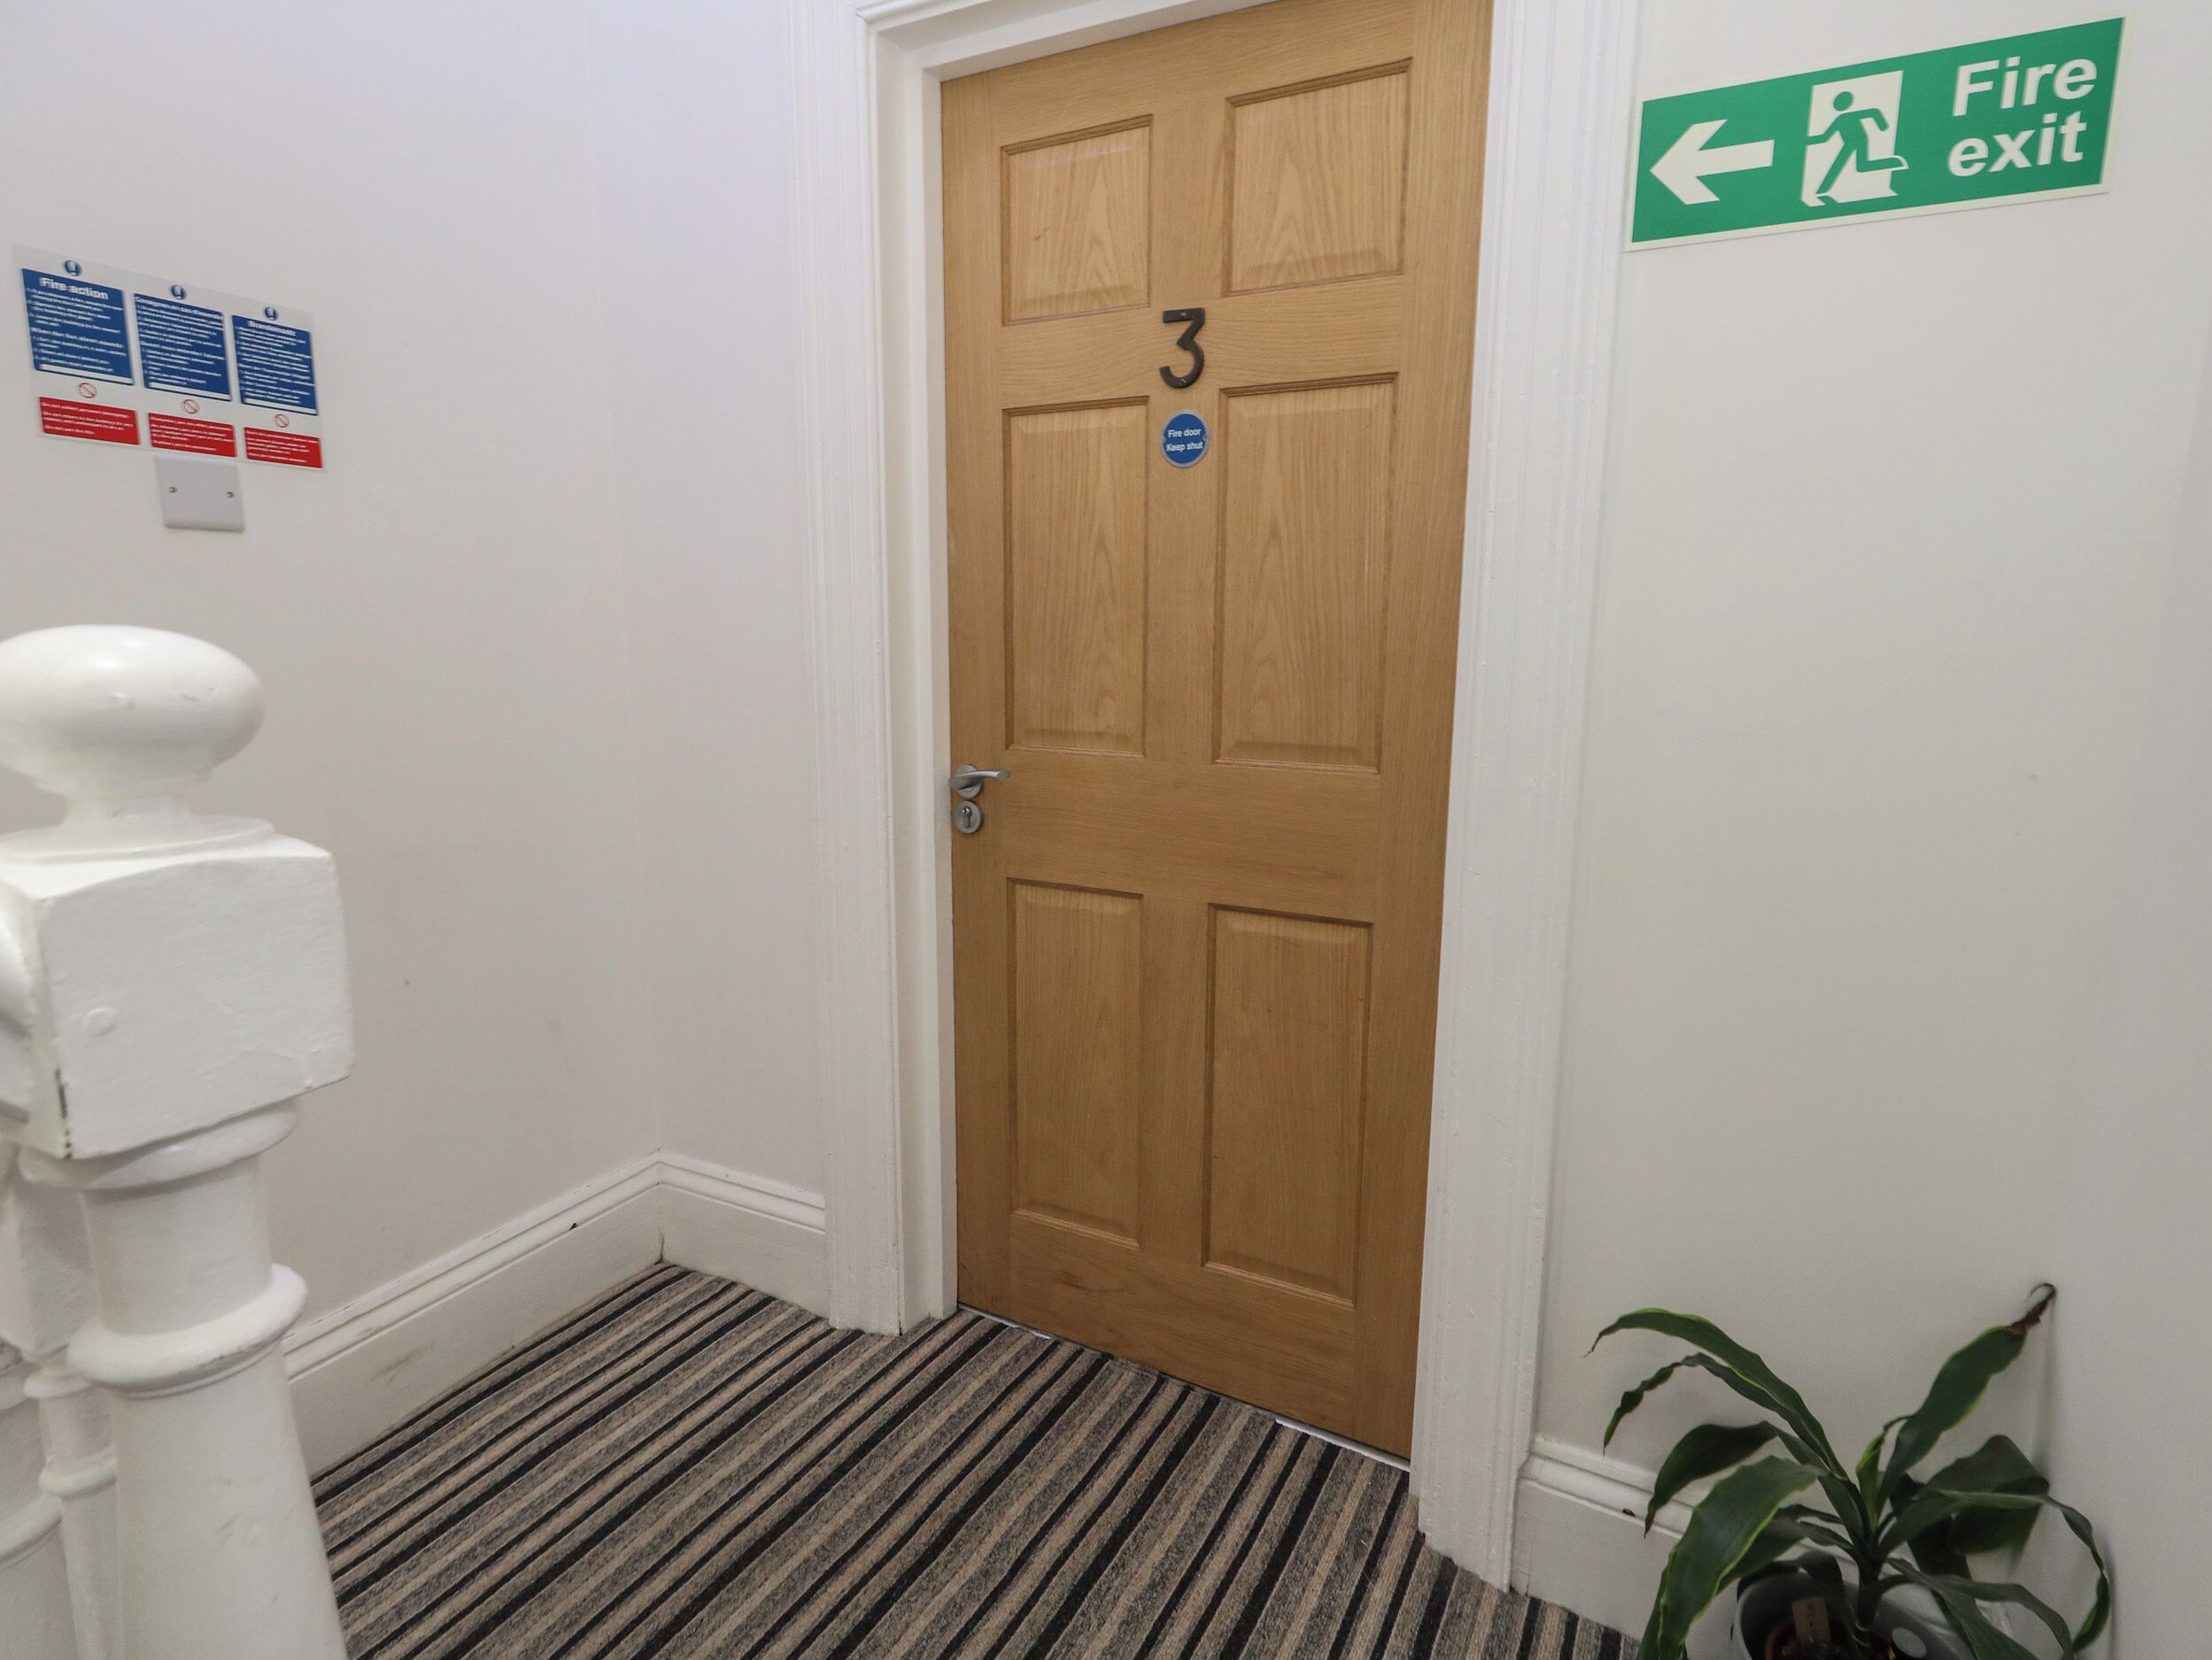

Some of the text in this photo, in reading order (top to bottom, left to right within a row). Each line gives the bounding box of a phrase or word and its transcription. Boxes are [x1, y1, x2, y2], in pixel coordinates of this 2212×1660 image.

[1953, 56, 2098, 117] Fire
[1948, 111, 2087, 177] exit
[39, 277, 109, 300] Fire action
[1159, 307, 1206, 390] 3
[1166, 444, 1186, 452] Keep
